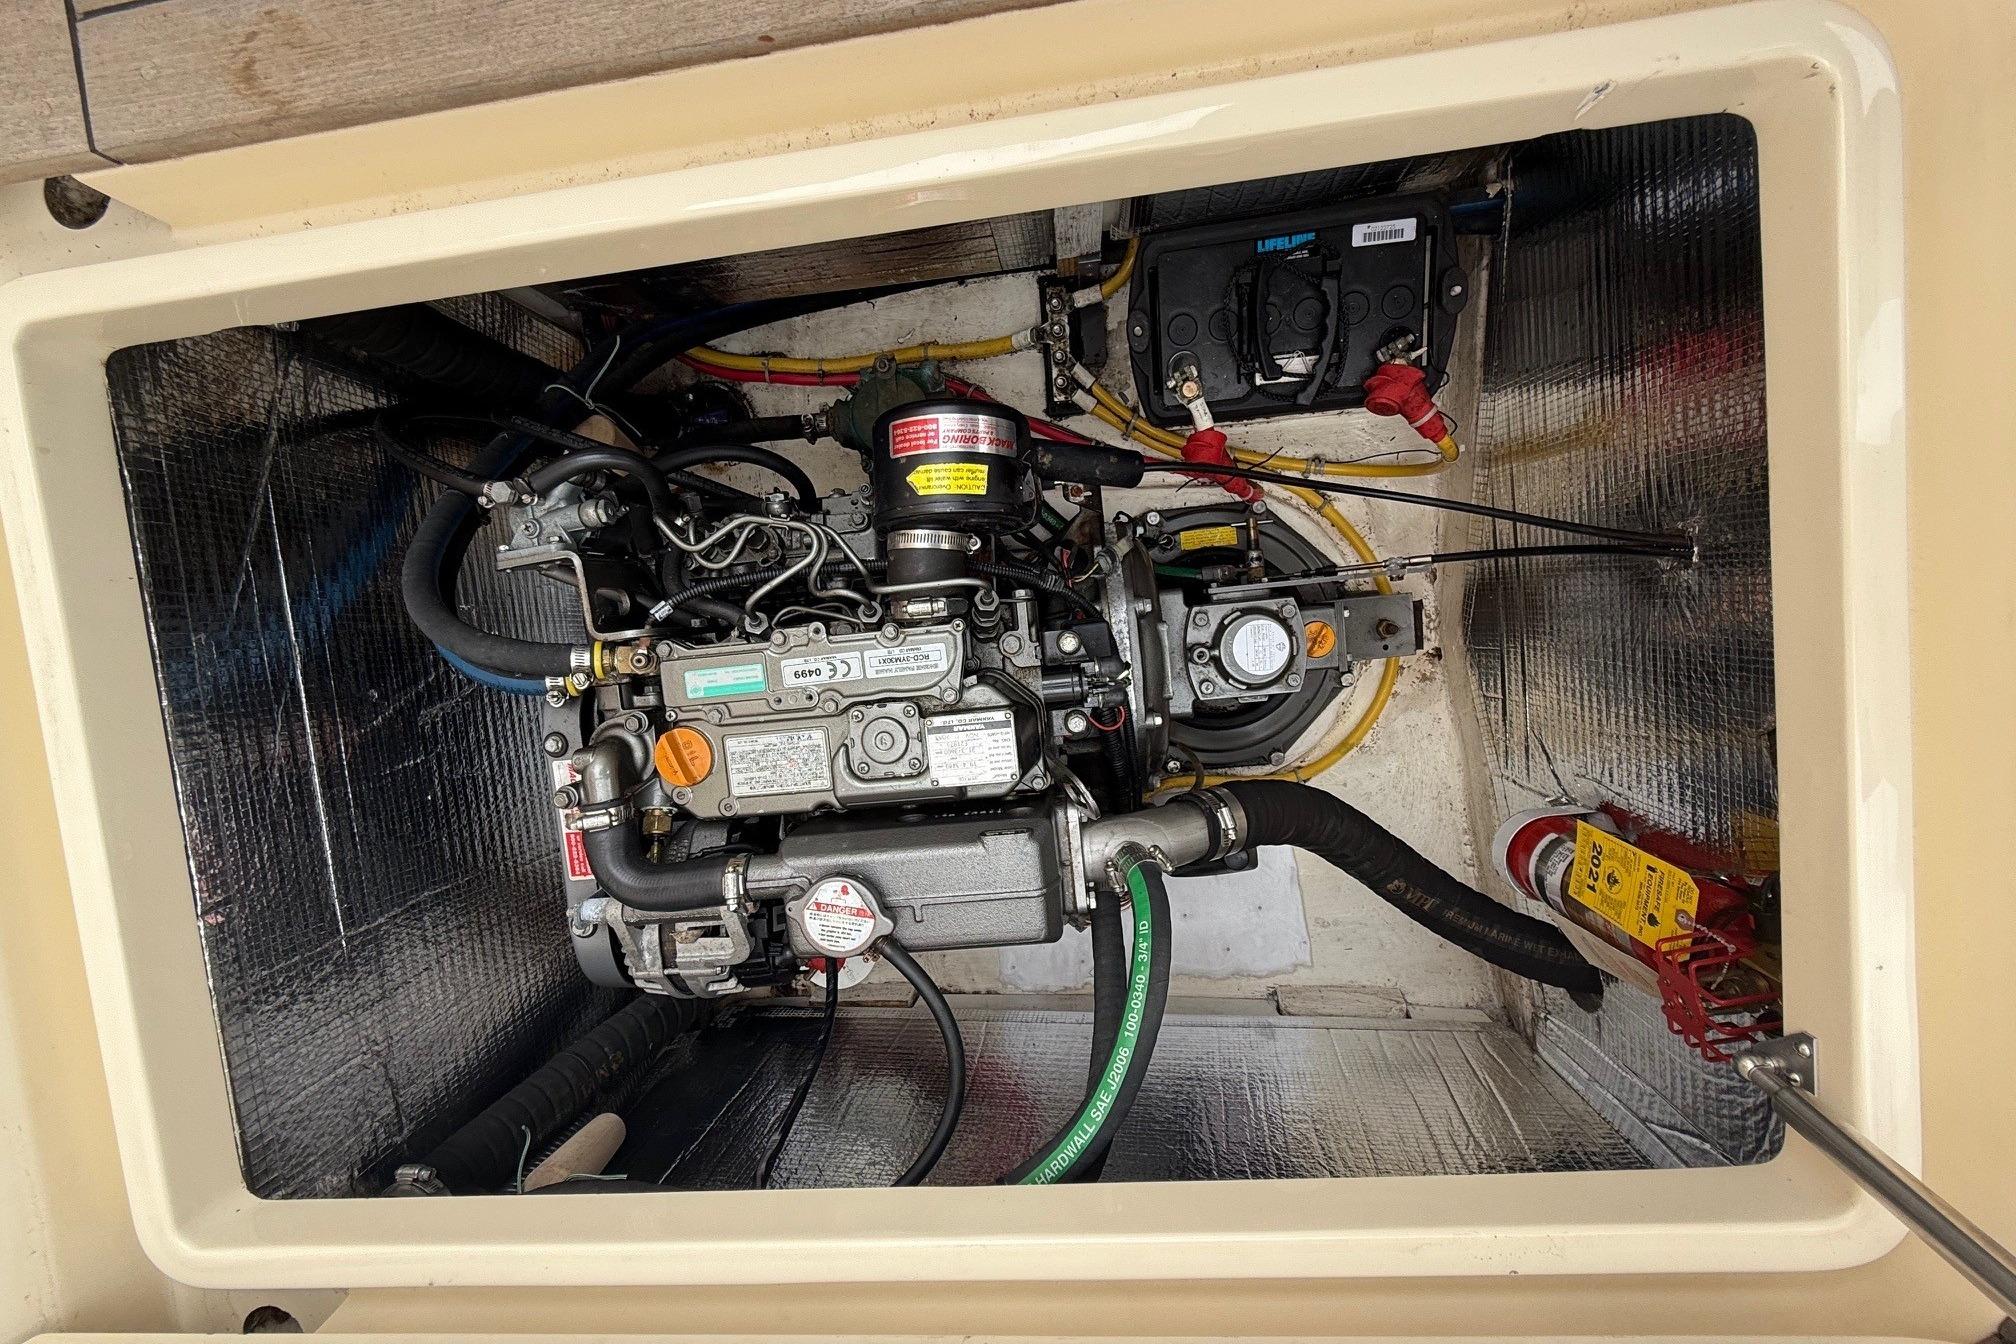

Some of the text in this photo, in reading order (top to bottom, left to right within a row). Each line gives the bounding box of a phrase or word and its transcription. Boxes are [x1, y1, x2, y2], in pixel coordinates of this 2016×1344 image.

[942, 434, 1015, 450] MACK BORING
[878, 653, 930, 665] RCD-3YM30X1
[793, 668, 822, 679] 0499
[953, 723, 986, 731] YANMAR
[1584, 840, 1603, 895] 2021
[1653, 870, 1666, 914] FIRESAFE
[820, 903, 858, 916] DANGER
[1548, 945, 1578, 962] EXHA
[1034, 1121, 1097, 1186] HARDWALL
[1093, 1091, 1113, 1124] SAE
[1108, 1047, 1130, 1092] J2006
[1123, 973, 1147, 1038] 100-0340
[1138, 920, 1150, 936] ID
